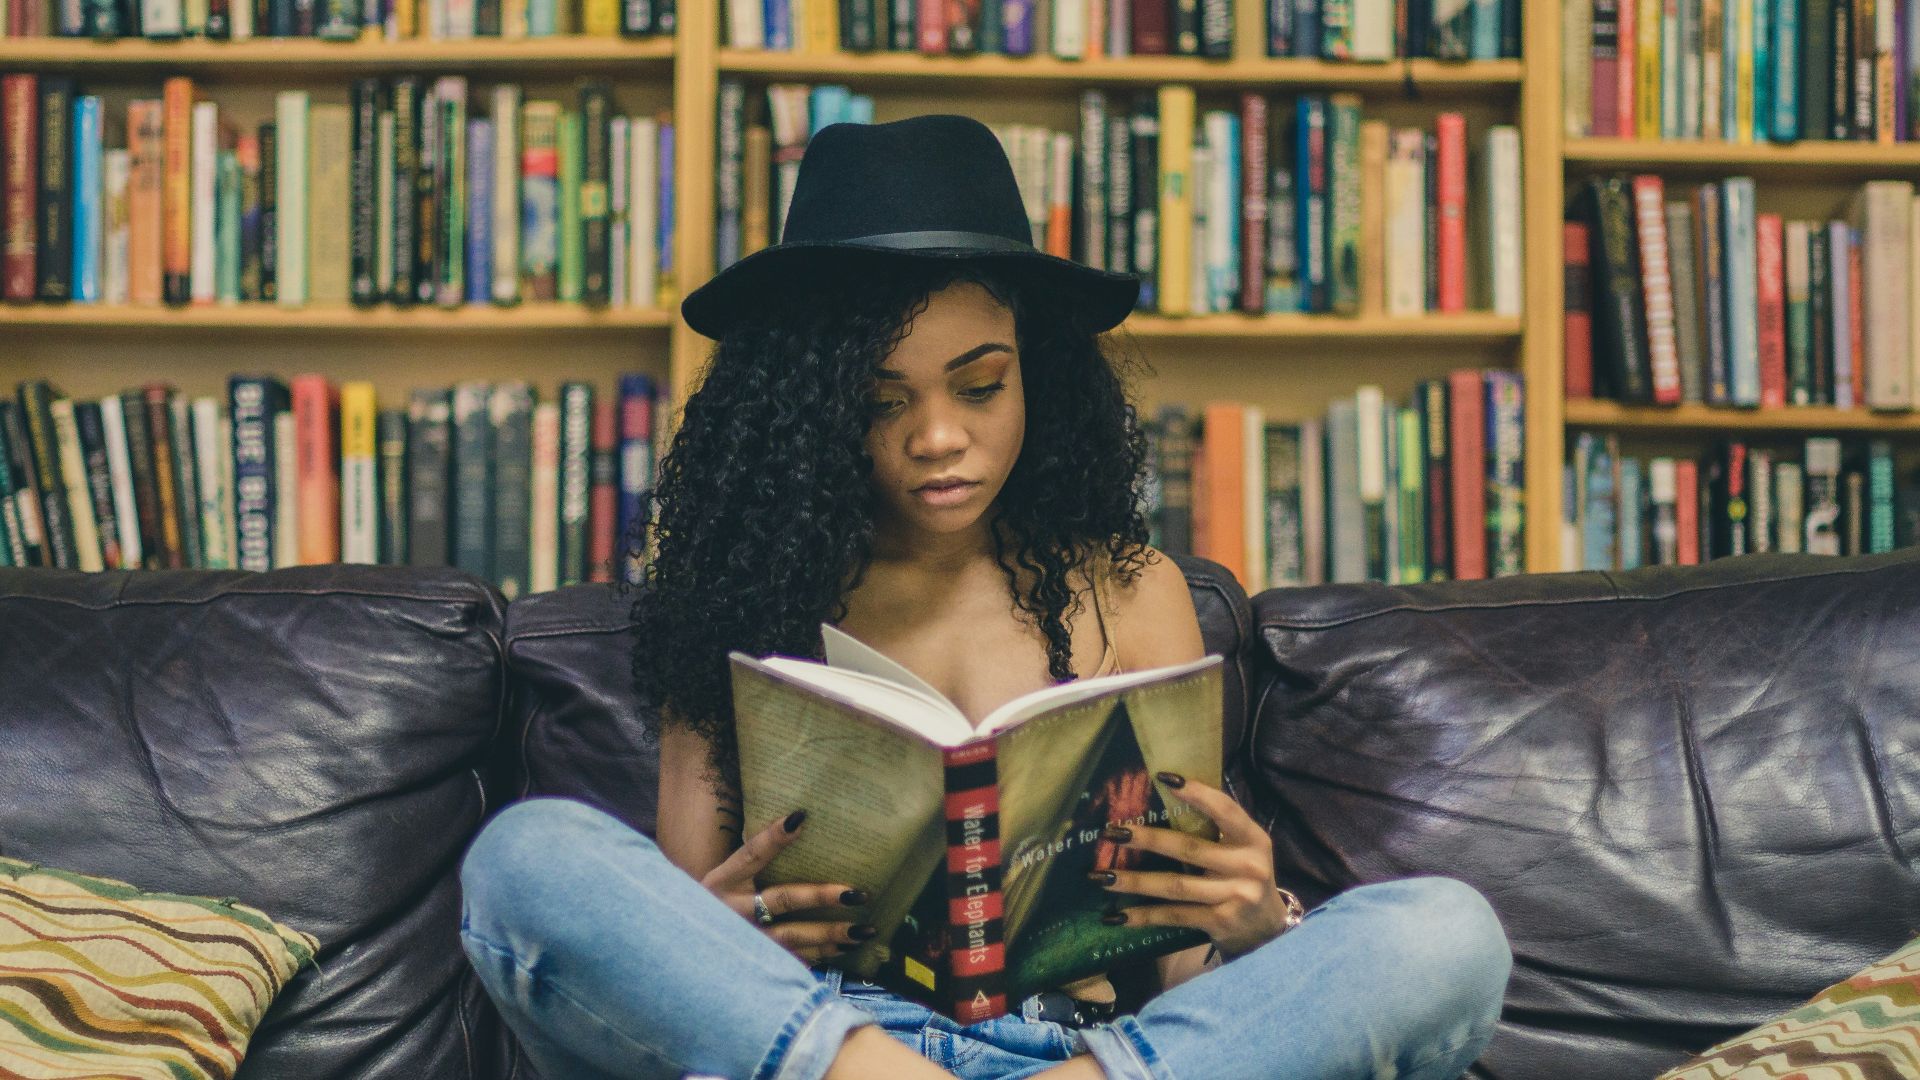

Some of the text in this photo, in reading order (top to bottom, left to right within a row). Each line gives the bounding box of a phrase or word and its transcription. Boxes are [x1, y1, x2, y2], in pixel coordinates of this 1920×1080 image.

[1022, 837, 1073, 868] Water
[1079, 829, 1100, 844] for
[963, 803, 989, 965] Water for Elephants
[1093, 943, 1134, 960] SARA
